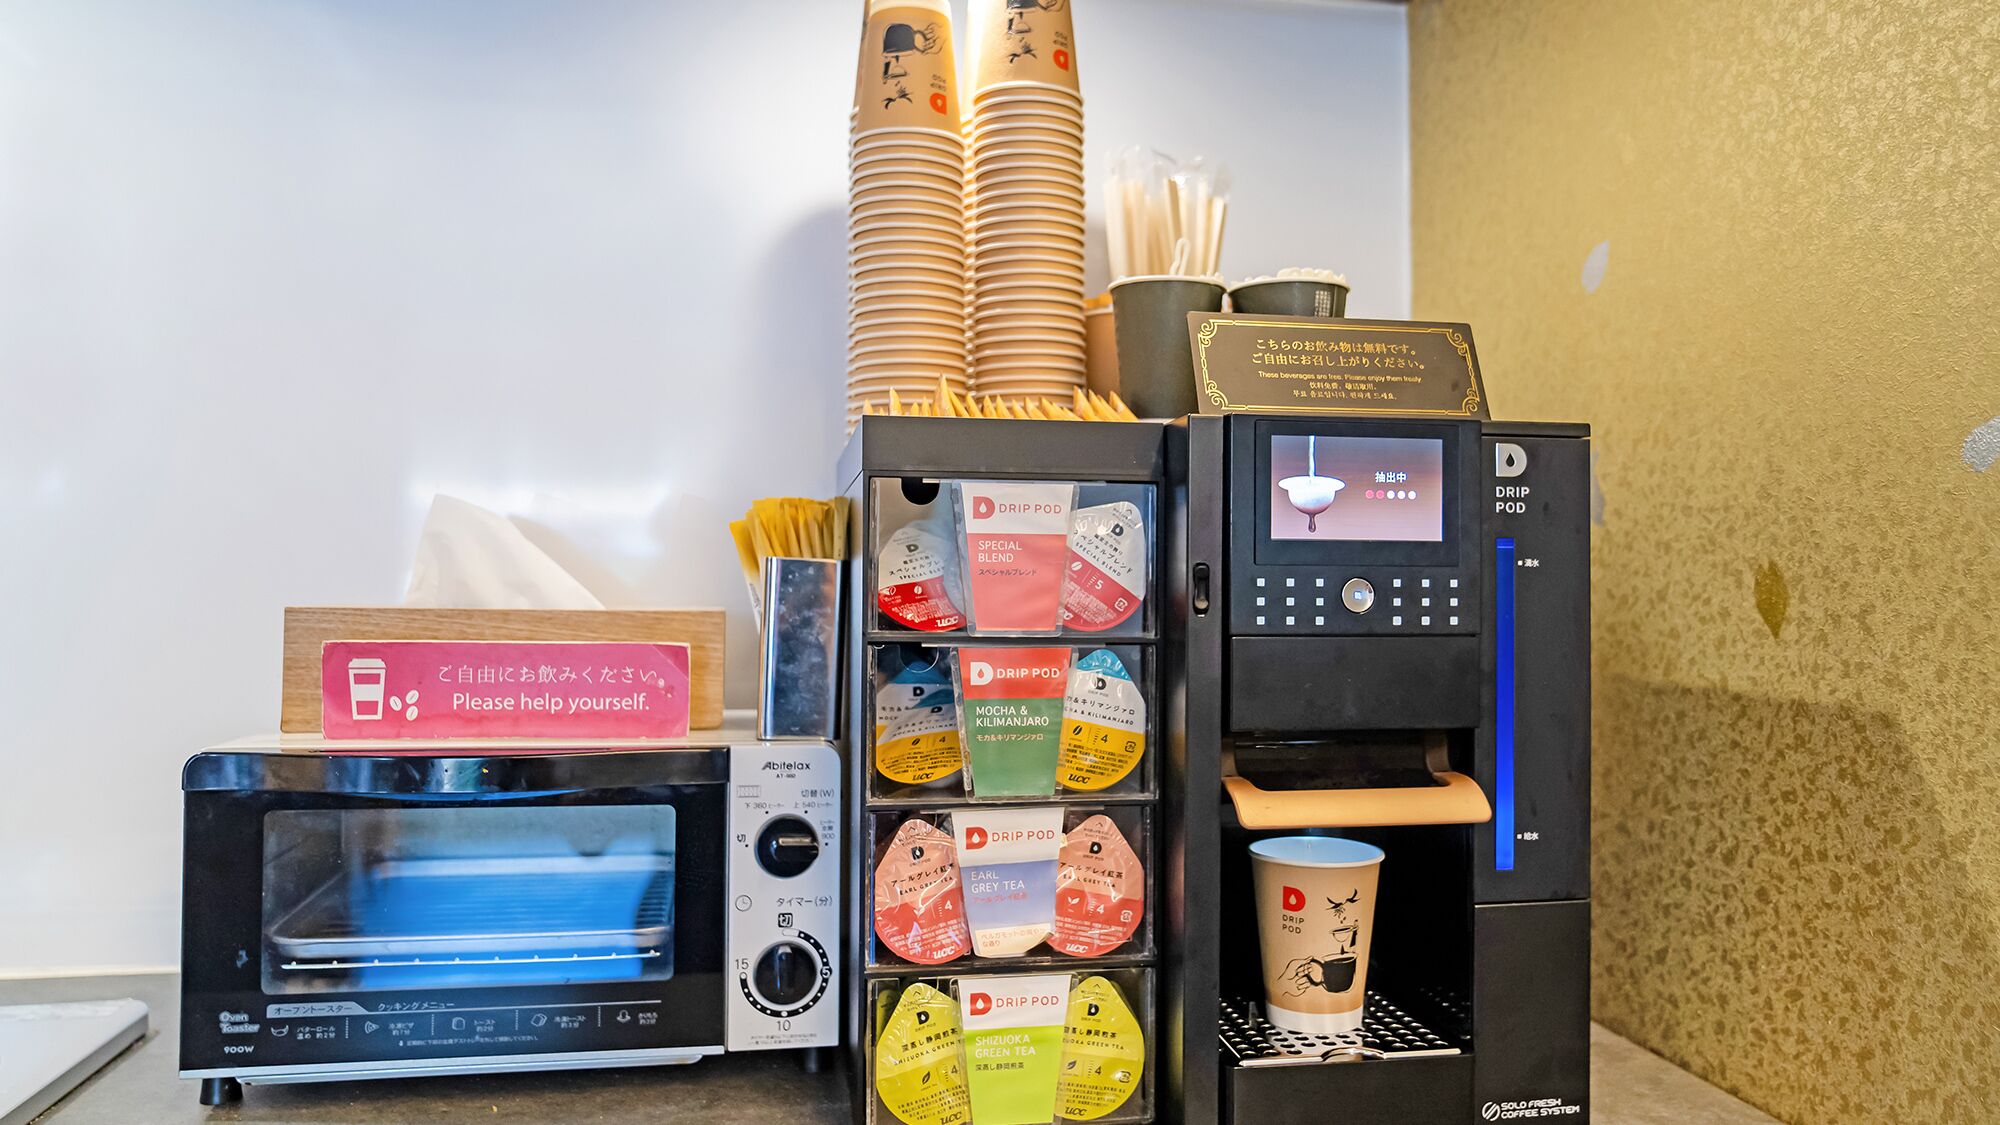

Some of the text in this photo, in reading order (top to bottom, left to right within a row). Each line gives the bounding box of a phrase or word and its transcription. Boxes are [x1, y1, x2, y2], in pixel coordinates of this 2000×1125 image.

[1255, 338, 1417, 356] こちらのお飲み物は無料です。
[1252, 352, 1425, 370] ご自由にお召し上がりください。
[1258, 370, 1279, 379] These
[1280, 371, 1315, 381] beverages
[1367, 375, 1385, 383] enjoy
[1375, 471, 1407, 484] 抽出中
[1495, 486, 1530, 498] DRIP
[999, 504, 1031, 514] DRIP
[1034, 503, 1062, 514] POD
[1495, 502, 1526, 513] POD
[978, 540, 1023, 551] SPECIAL
[978, 553, 1014, 563] BLEND
[1076, 542, 1100, 562] SPECIAL
[1101, 561, 1121, 576] BLEND
[979, 568, 1037, 576] スペシャルブレンド
[1095, 579, 1103, 589] 5
[439, 664, 666, 688] ご自由にお飲みください。
[997, 668, 1029, 679] DRIP
[1032, 667, 1060, 679] POD
[453, 692, 650, 715] Please help yourself.
[976, 705, 1028, 716] MOCHA &
[976, 716, 1049, 727] KILIMANJARO
[1088, 712, 1134, 725] KILIMANJARO
[1101, 734, 1108, 743] 4
[761, 761, 811, 771] Abitelax
[1068, 774, 1091, 784] UCC
[736, 833, 747, 843] 切
[991, 831, 1024, 842] DRIP
[1027, 830, 1055, 841] POD
[971, 871, 999, 881] EARL
[900, 886, 917, 896] EARL
[971, 880, 1025, 893] GREY TEA
[944, 900, 953, 910] 4
[1096, 904, 1105, 915] 4
[778, 914, 792, 926] 切
[1282, 914, 1305, 924] DRIP
[1282, 924, 1302, 934] POD
[933, 946, 955, 959] UCC
[1066, 943, 1089, 954] UCC
[735, 958, 749, 970] 15
[822, 966, 831, 978] 5
[378, 1001, 455, 1012] クッキングメニュー
[996, 997, 1027, 1008] DRIP
[1031, 995, 1059, 1006] POD
[219, 1011, 249, 1022] Oven
[220, 1023, 260, 1034] Toaster
[776, 1020, 792, 1032] 10
[975, 1034, 1030, 1046] SHIZUOKA
[224, 1046, 254, 1054] 900W
[932, 1041, 955, 1052] GREEN
[975, 1046, 1037, 1059] GREEN TEA
[951, 1065, 958, 1074] 4
[1095, 1066, 1101, 1075] 4
[1501, 1098, 1561, 1110] SOLO FRESH
[1065, 1106, 1087, 1116] UCC
[1501, 1105, 1580, 1119] COFFEE SYSTEM
[940, 1111, 962, 1125] UCC
